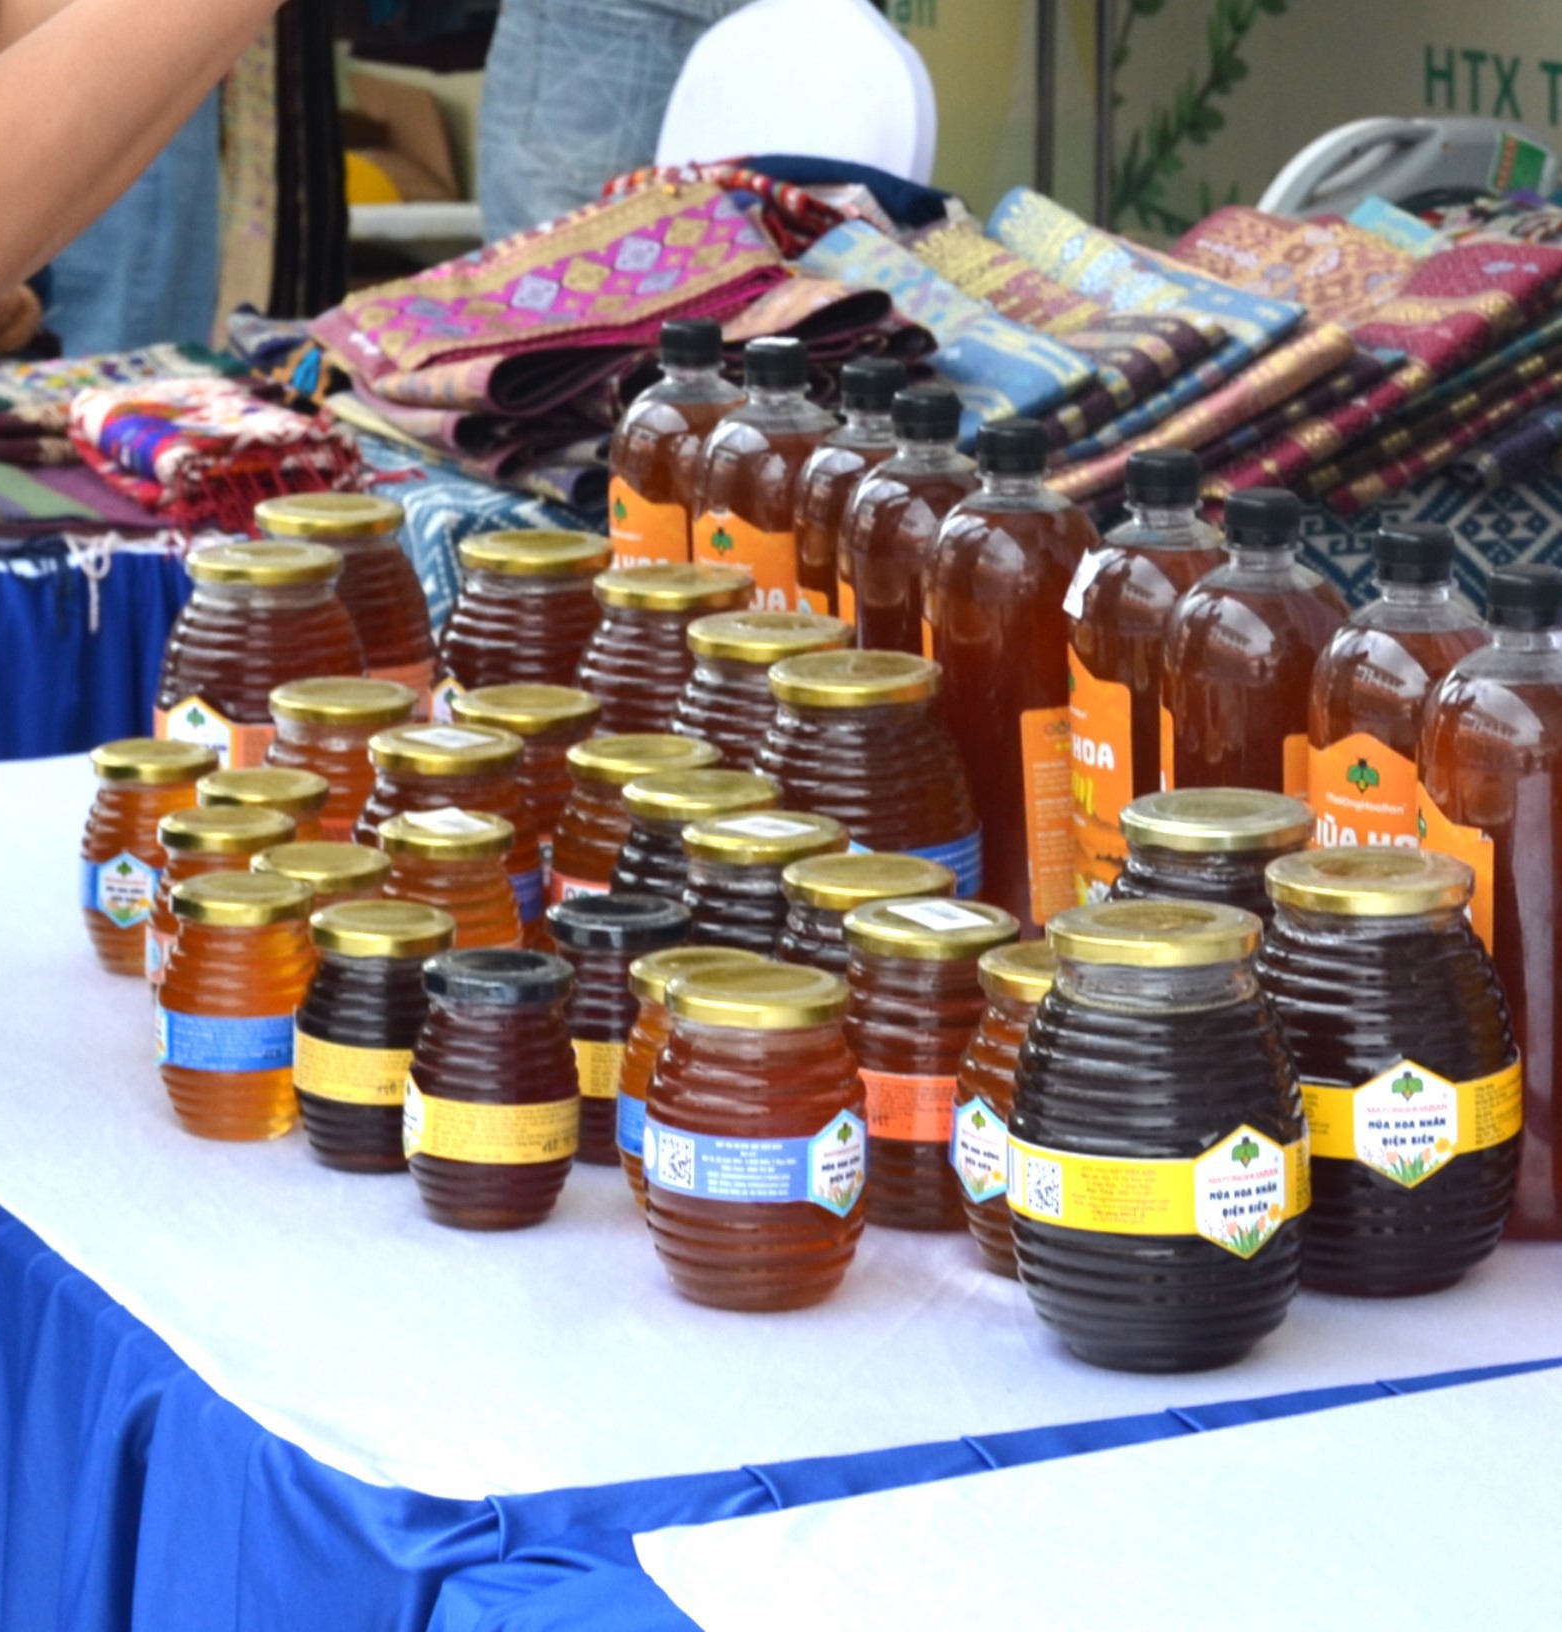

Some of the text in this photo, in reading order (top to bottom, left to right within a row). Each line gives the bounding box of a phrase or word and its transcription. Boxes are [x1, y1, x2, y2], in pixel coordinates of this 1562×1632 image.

[1424, 44, 1522, 121] HTX
[1394, 1119, 1416, 1129] HOA
[1234, 1187, 1253, 1199] HOA
